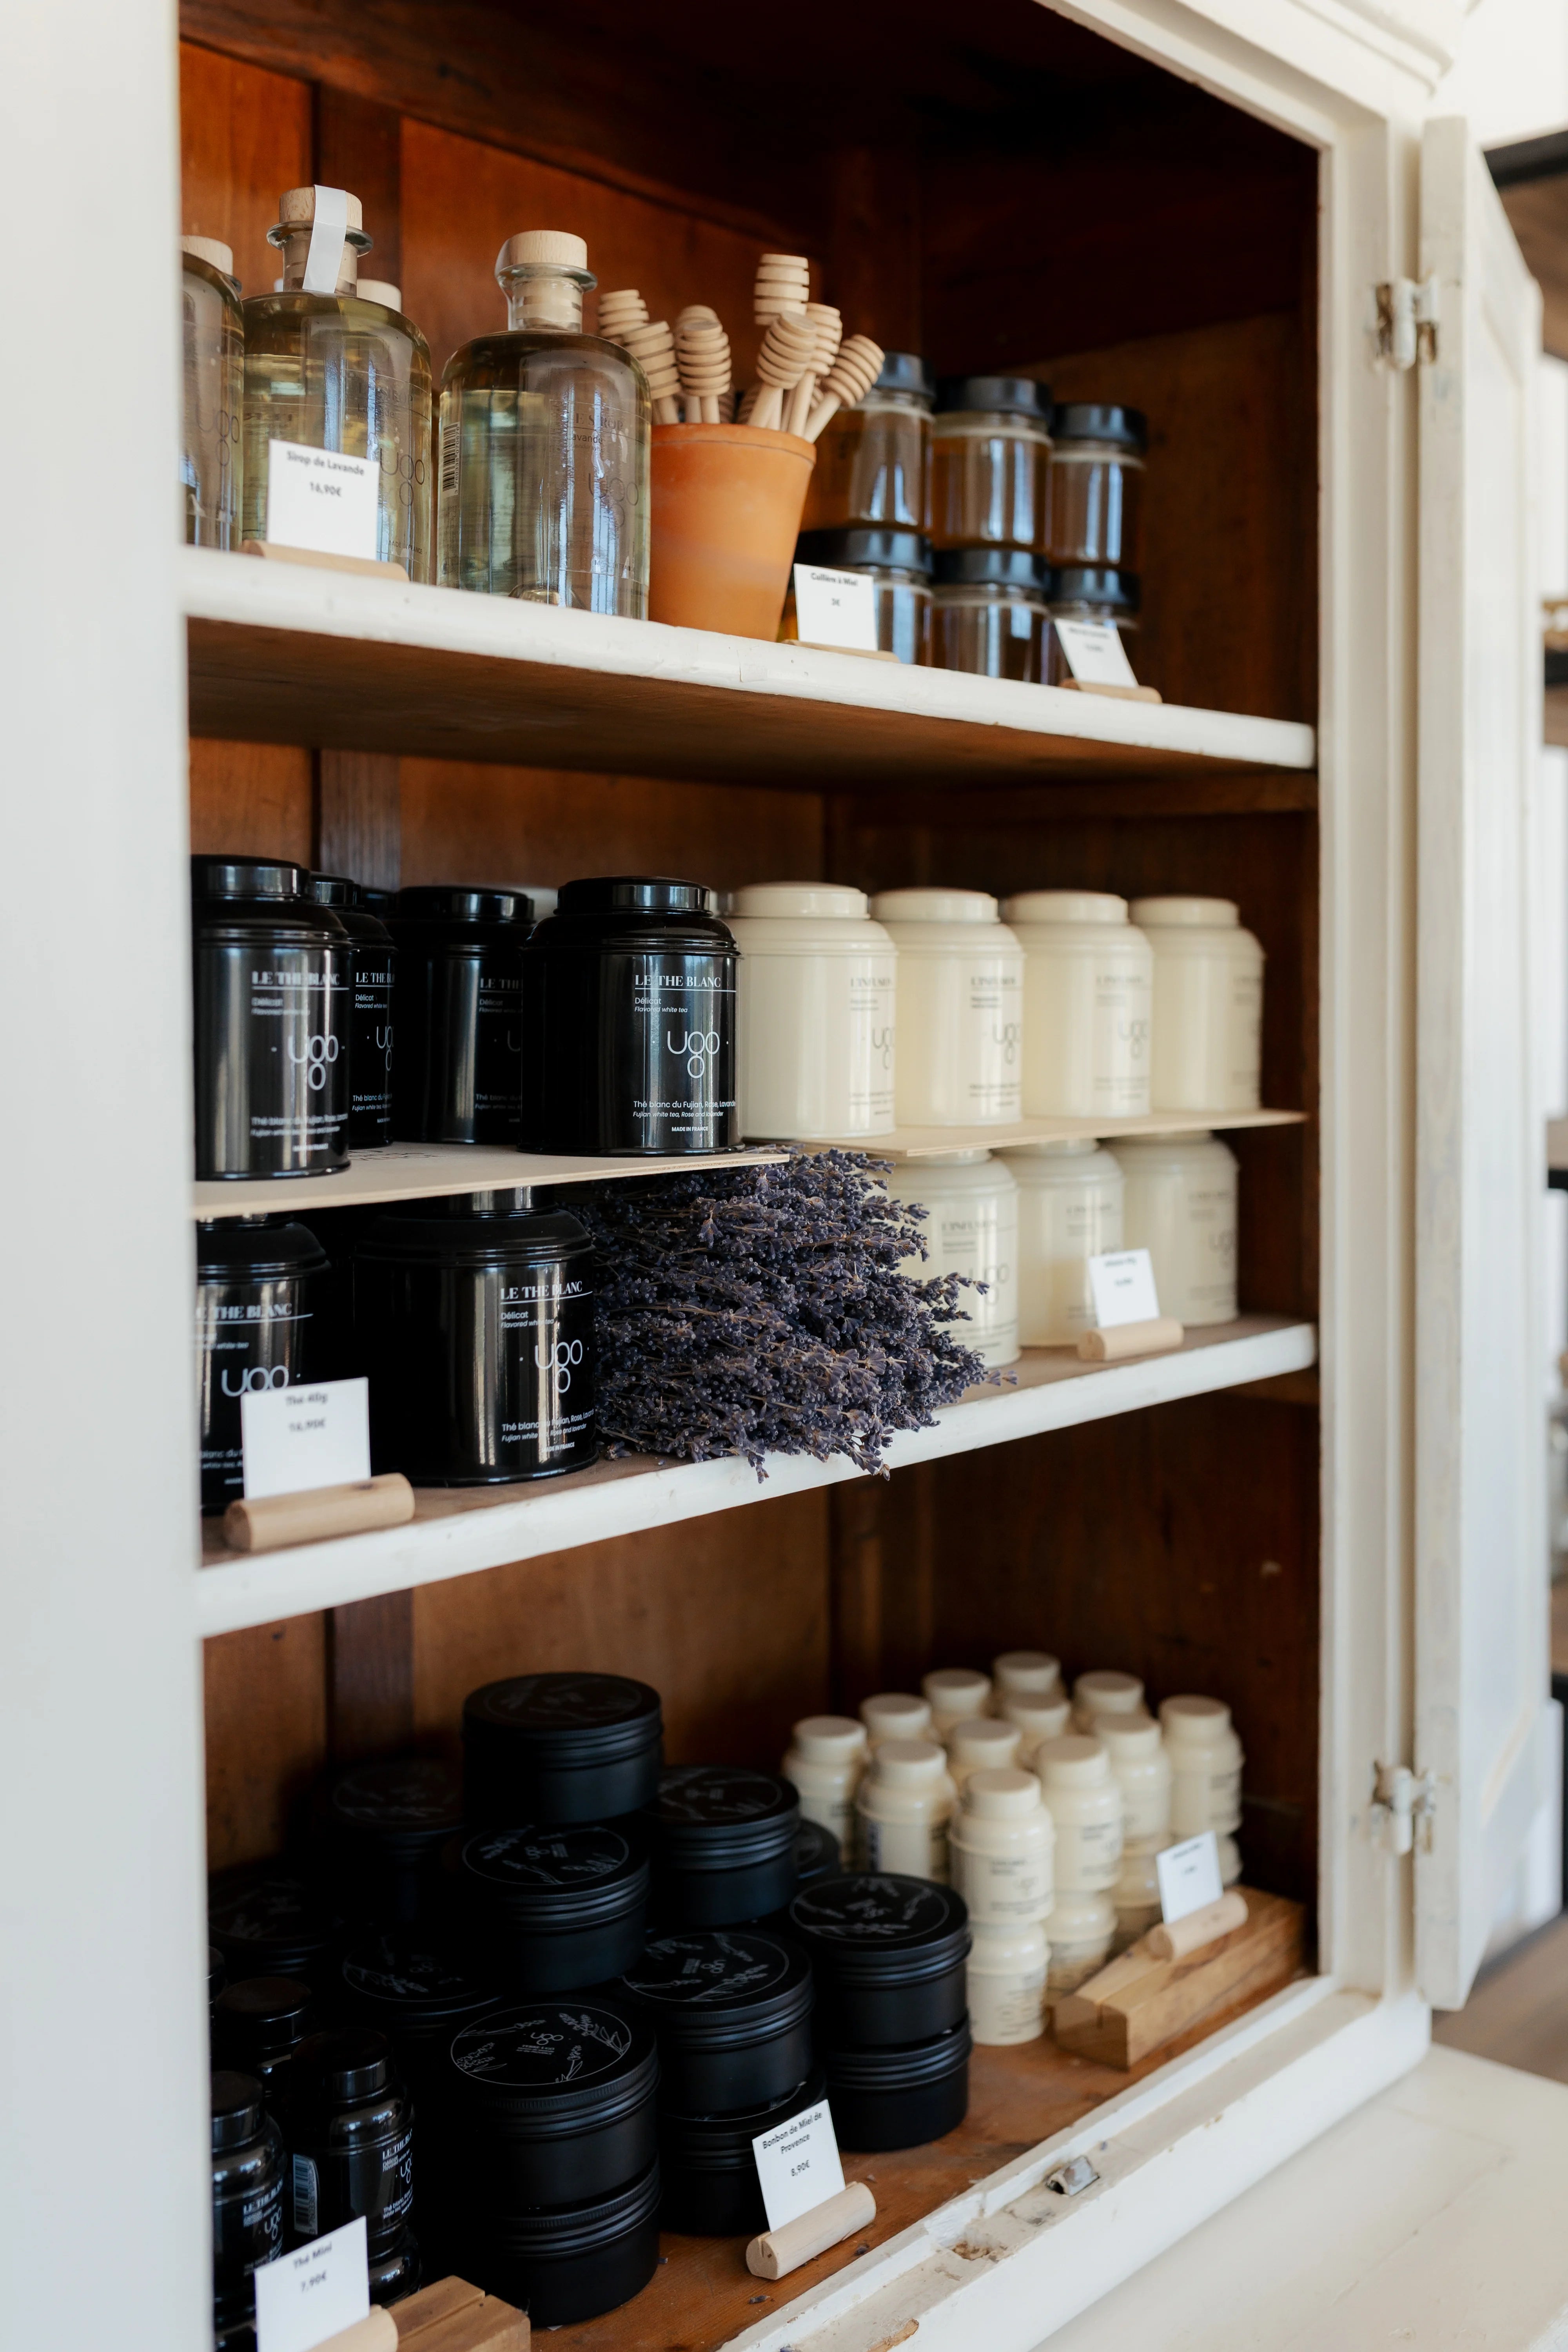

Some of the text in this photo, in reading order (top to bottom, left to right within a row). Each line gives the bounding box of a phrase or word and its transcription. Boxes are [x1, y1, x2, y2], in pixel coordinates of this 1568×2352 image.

[287, 450, 365, 475] Sirop de Lavande
[356, 972, 368, 982] LE
[370, 973, 386, 983] THE
[481, 978, 495, 988] LE
[635, 975, 721, 988] LE THE BLANC
[683, 1101, 704, 1110] Fujian,
[500, 1280, 582, 1300] LE THE BLANC
[501, 1311, 529, 1320] Délicat
[501, 1320, 528, 1328] Flavored
[502, 1422, 516, 1432] Thé
[571, 1413, 583, 1423] Rose,
[502, 1435, 521, 1443] Fujian
[762, 2112, 822, 2149] Bonbon de Miel de
[780, 2134, 811, 2154] Provence
[383, 2148, 392, 2161] LE
[791, 2159, 811, 2176] 8,90€
[294, 2241, 332, 2269] Thé Mini
